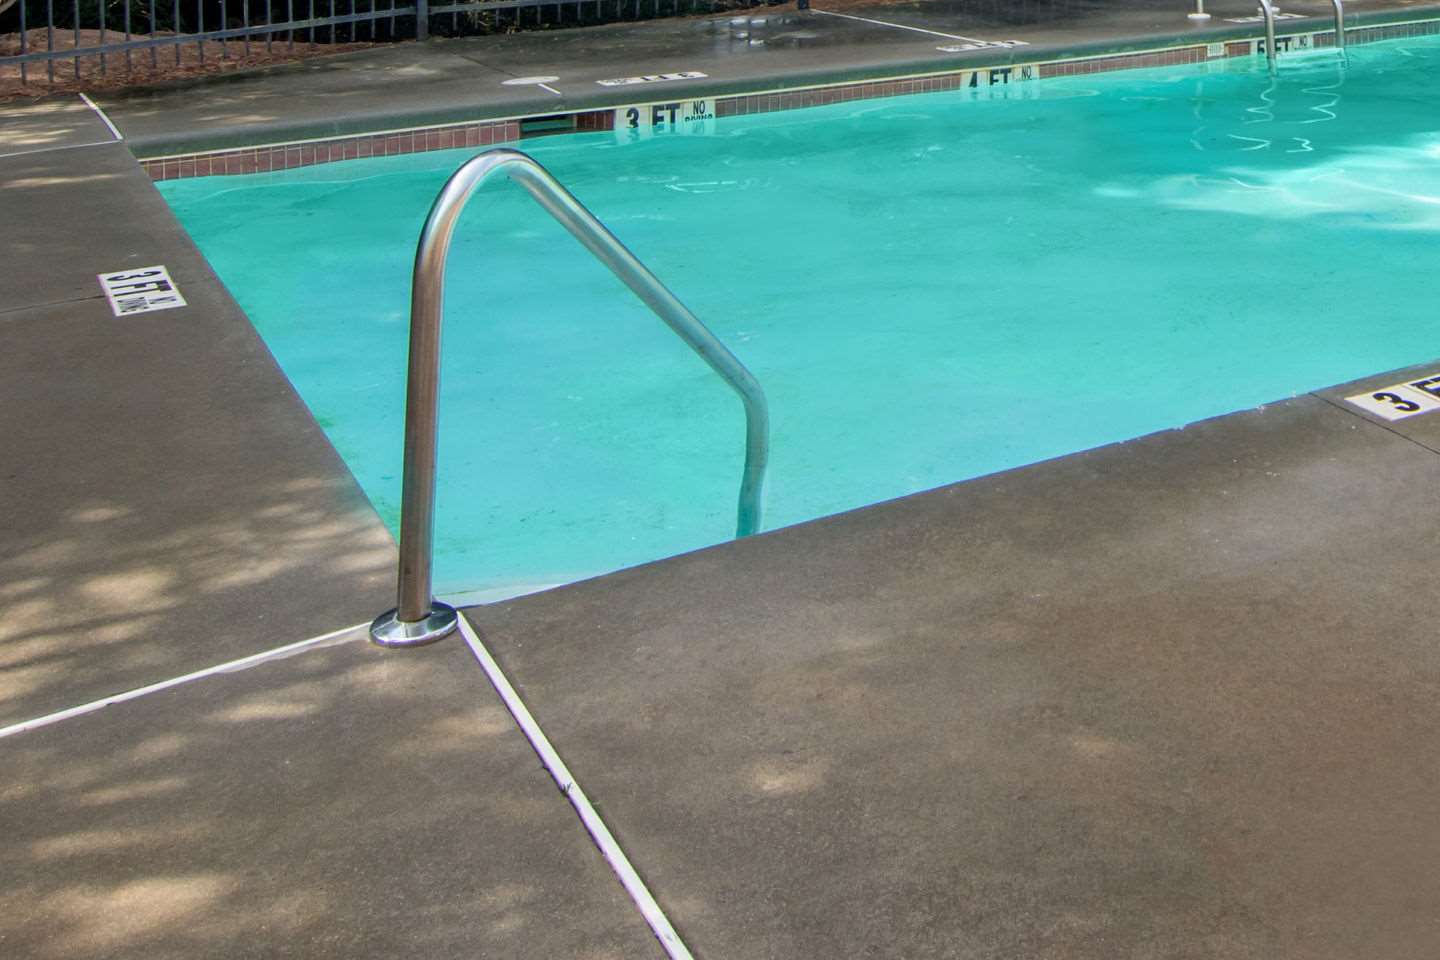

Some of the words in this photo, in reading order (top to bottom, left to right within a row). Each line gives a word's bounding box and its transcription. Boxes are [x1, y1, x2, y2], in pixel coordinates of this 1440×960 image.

[989, 67, 1013, 86] FT
[1021, 64, 1032, 79] NO
[625, 107, 640, 129] 3
[651, 102, 681, 127] FT
[692, 100, 706, 115] NO
[106, 270, 163, 282] 3
[110, 279, 173, 297] FT
[1372, 391, 1421, 412] 3
